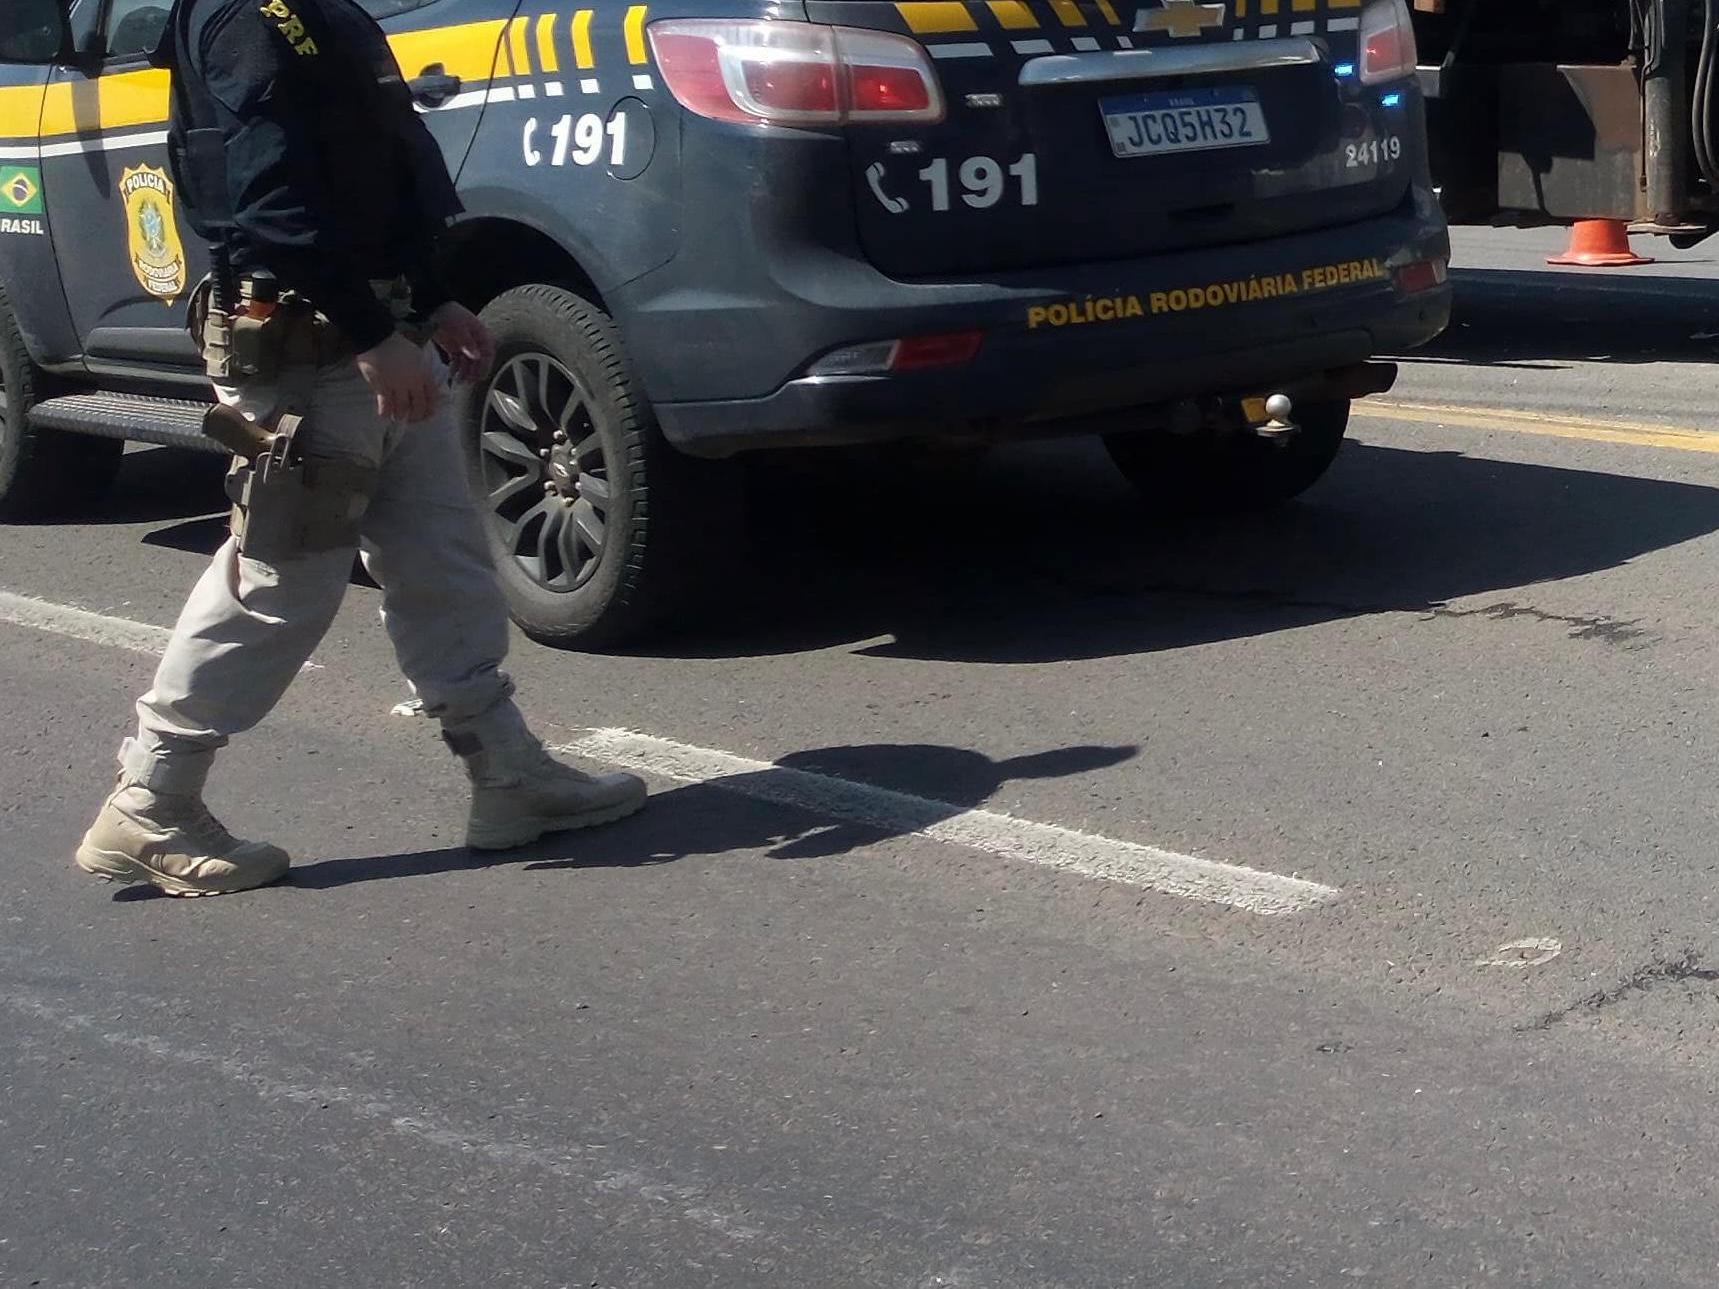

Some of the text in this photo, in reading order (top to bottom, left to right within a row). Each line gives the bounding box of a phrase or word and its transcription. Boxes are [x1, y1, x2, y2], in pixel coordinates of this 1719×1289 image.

[551, 111, 626, 166] 191
[1127, 106, 1253, 148] JCQ5H32
[1345, 135, 1401, 168] 24119
[918, 152, 1039, 212] 191
[0, 218, 44, 235] RASIL
[1028, 257, 1385, 329] POLÍCIA RODOVIÁRIA FEDERAL
